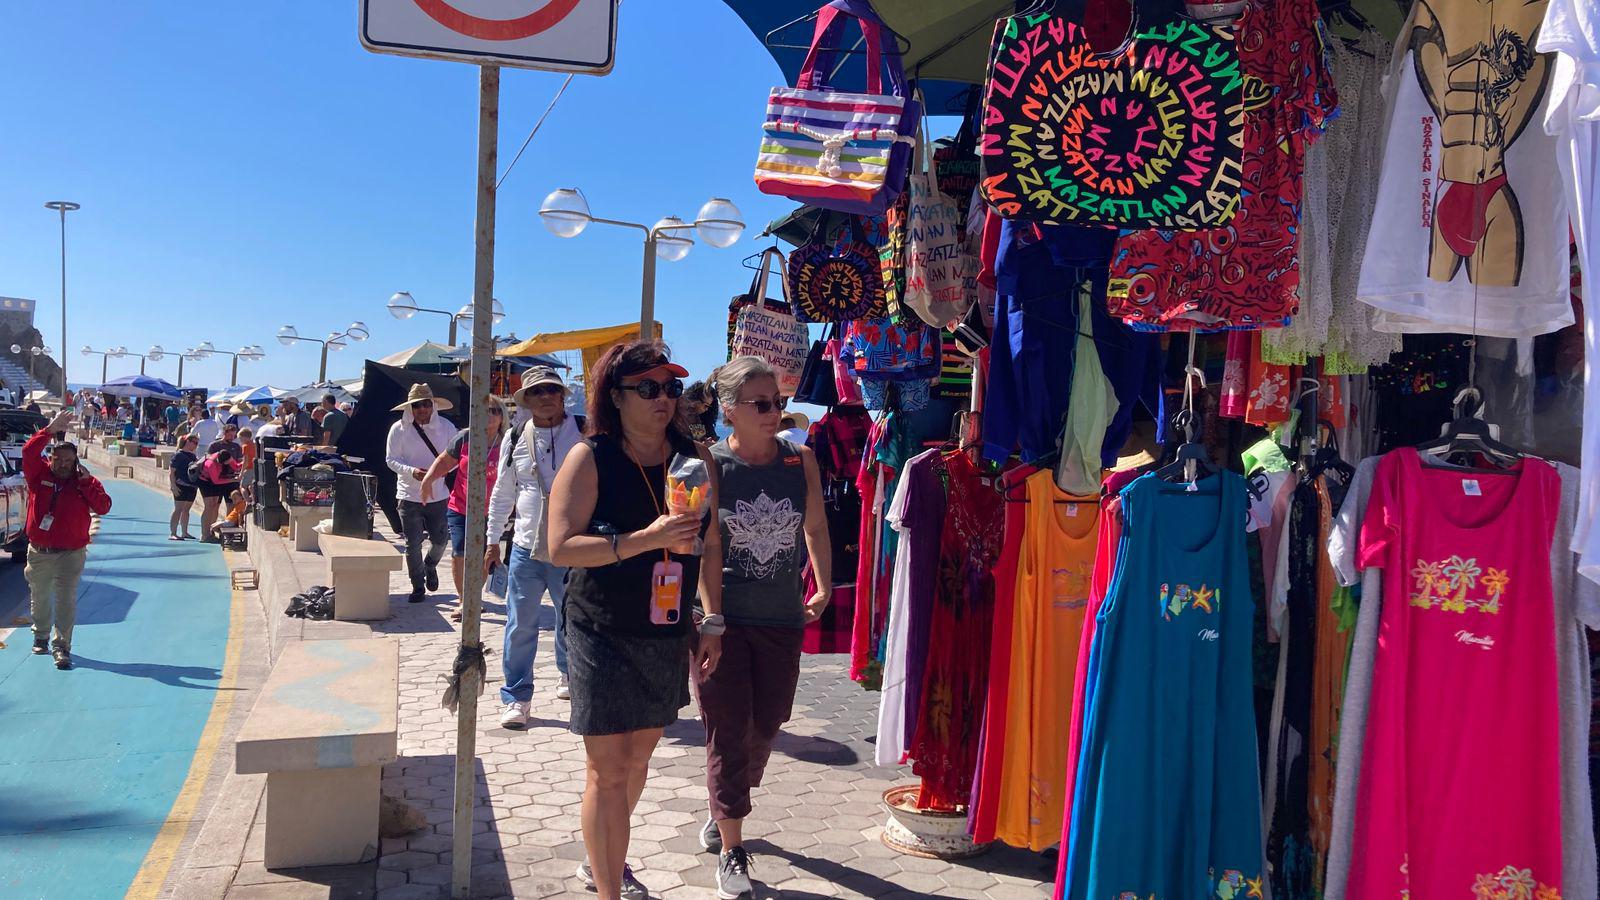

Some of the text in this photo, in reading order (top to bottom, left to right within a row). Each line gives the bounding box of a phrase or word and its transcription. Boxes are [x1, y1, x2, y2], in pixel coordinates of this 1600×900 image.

[1035, 70, 1124, 160] MAZATLAN
[1062, 103, 1133, 195] MAZATLAN
[1085, 97, 1160, 173] MAZATLAN
[1130, 70, 1185, 188] MAZATLAN
[1144, 45, 1217, 187] MAZATLAN
[1044, 165, 1187, 220] MAZATLAN
[1422, 117, 1433, 227] MAZATLAN SINALOA
